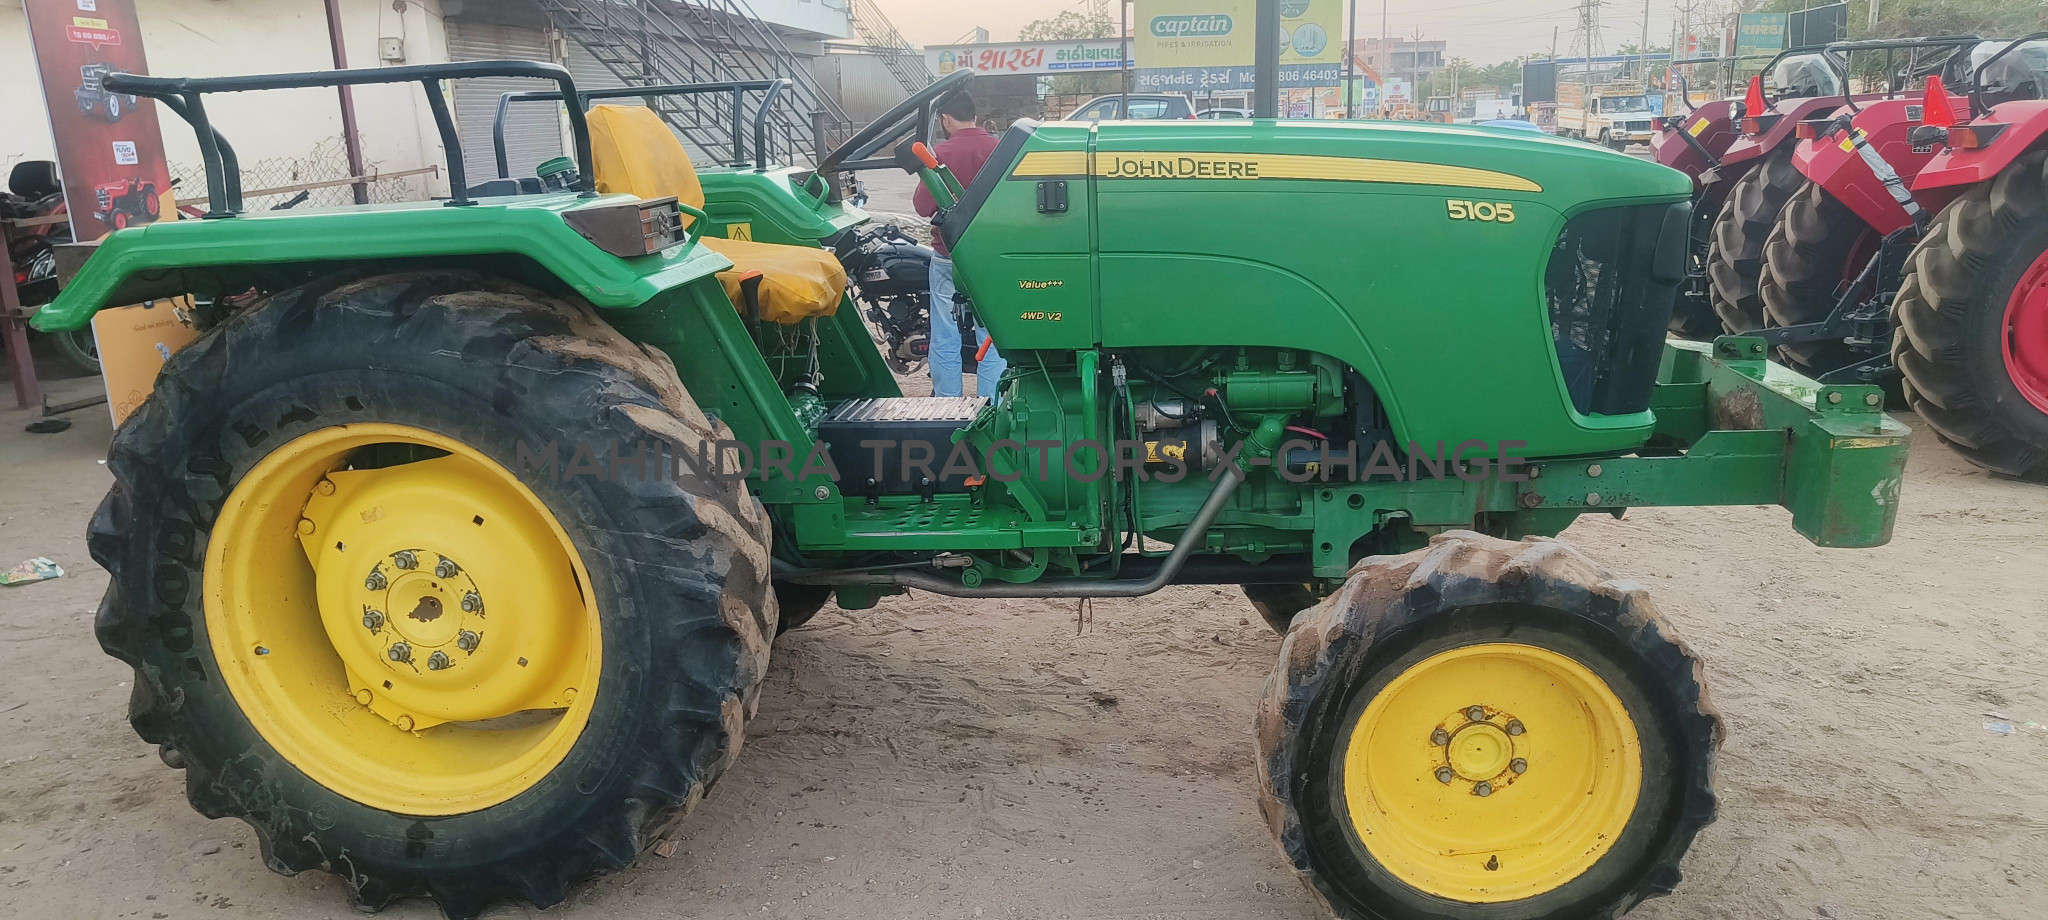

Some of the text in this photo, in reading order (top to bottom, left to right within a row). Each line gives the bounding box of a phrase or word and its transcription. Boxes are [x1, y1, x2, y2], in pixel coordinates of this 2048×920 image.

[1155, 15, 1228, 37] captain
[1188, 40, 1232, 48] IRRIGATION
[977, 48, 1045, 71] શારદા
[1056, 44, 1123, 60] કાઠીયાવાડ
[1302, 70, 1338, 80] 46403
[1107, 157, 1259, 177] JOHN DEERE
[1446, 199, 1515, 223] 5105
[1020, 311, 1062, 321] 4WD V2
